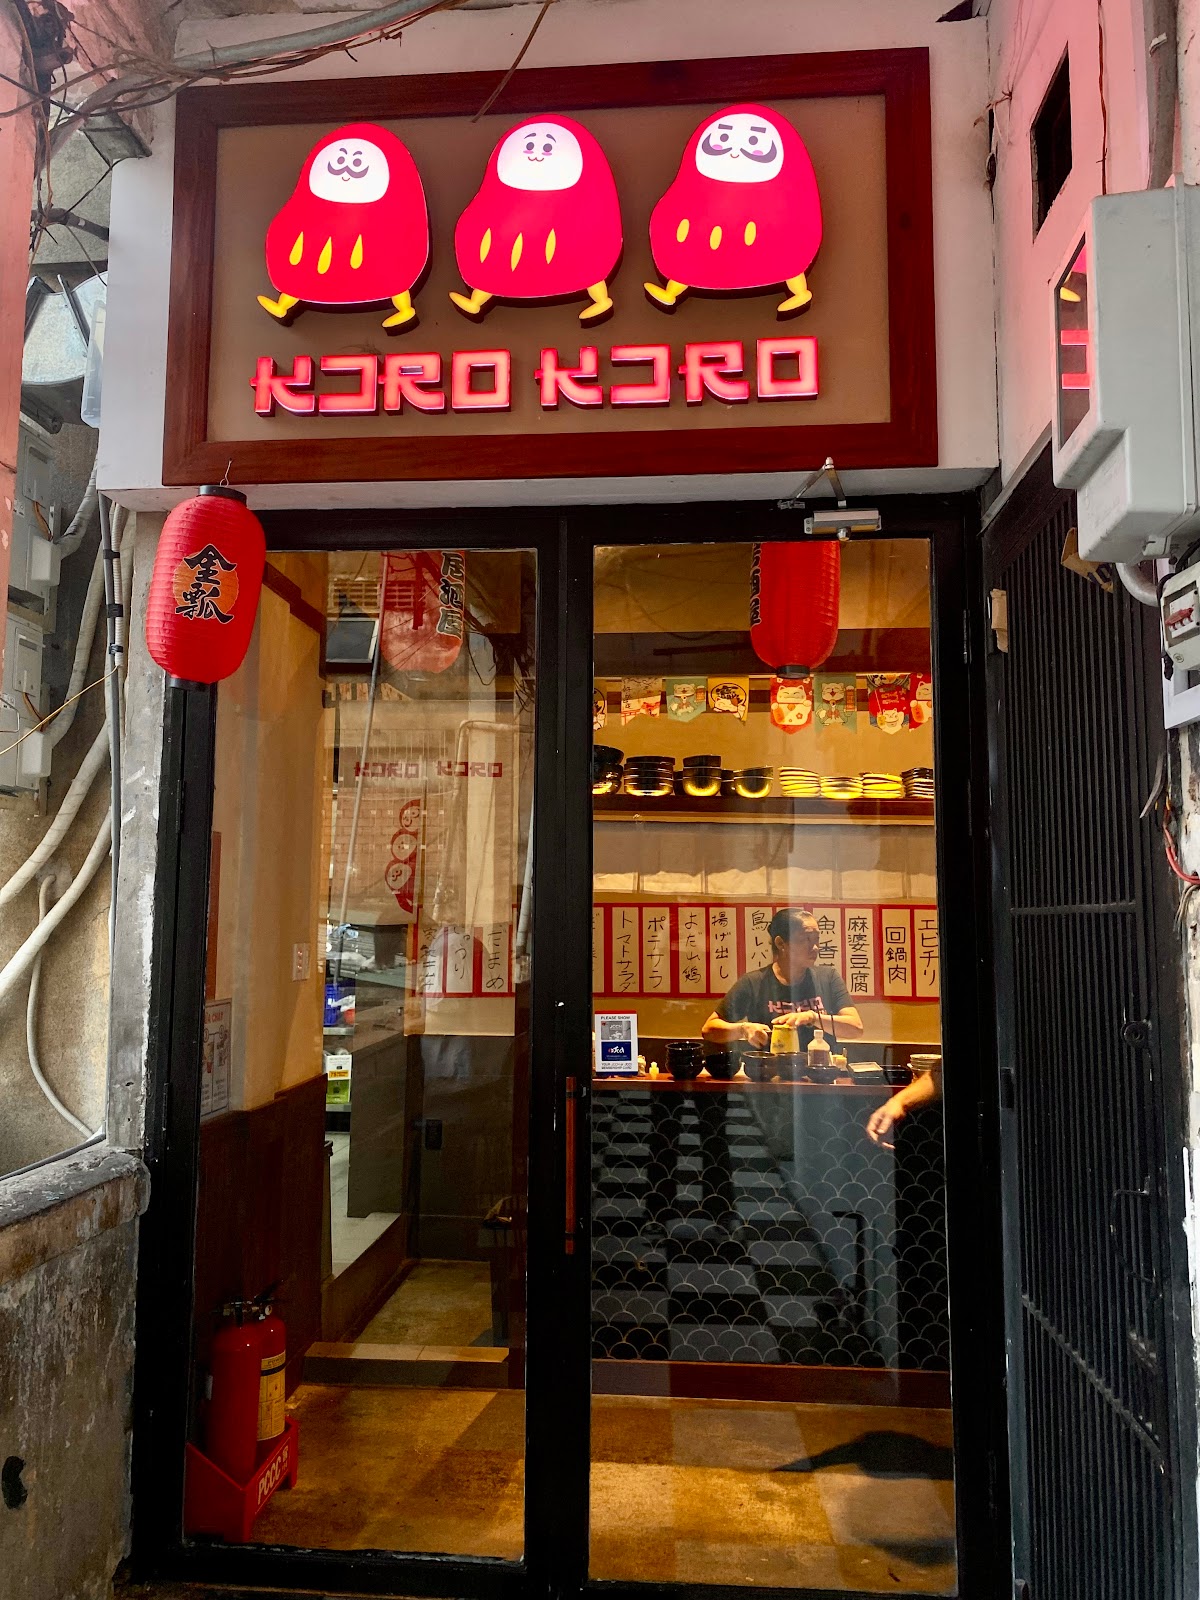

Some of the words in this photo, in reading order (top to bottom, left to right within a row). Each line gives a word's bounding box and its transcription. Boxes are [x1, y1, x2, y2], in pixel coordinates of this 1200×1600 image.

[616, 910, 637, 993] トマトサラダ
[646, 915, 667, 989] ポテサラ
[711, 910, 732, 980] 揚げ出し
[848, 915, 871, 994] 麻婆豆腐
[885, 926, 908, 985] 回鍋肉
[917, 918, 940, 987] エビチリ
[257, 1455, 282, 1506] PCCC
